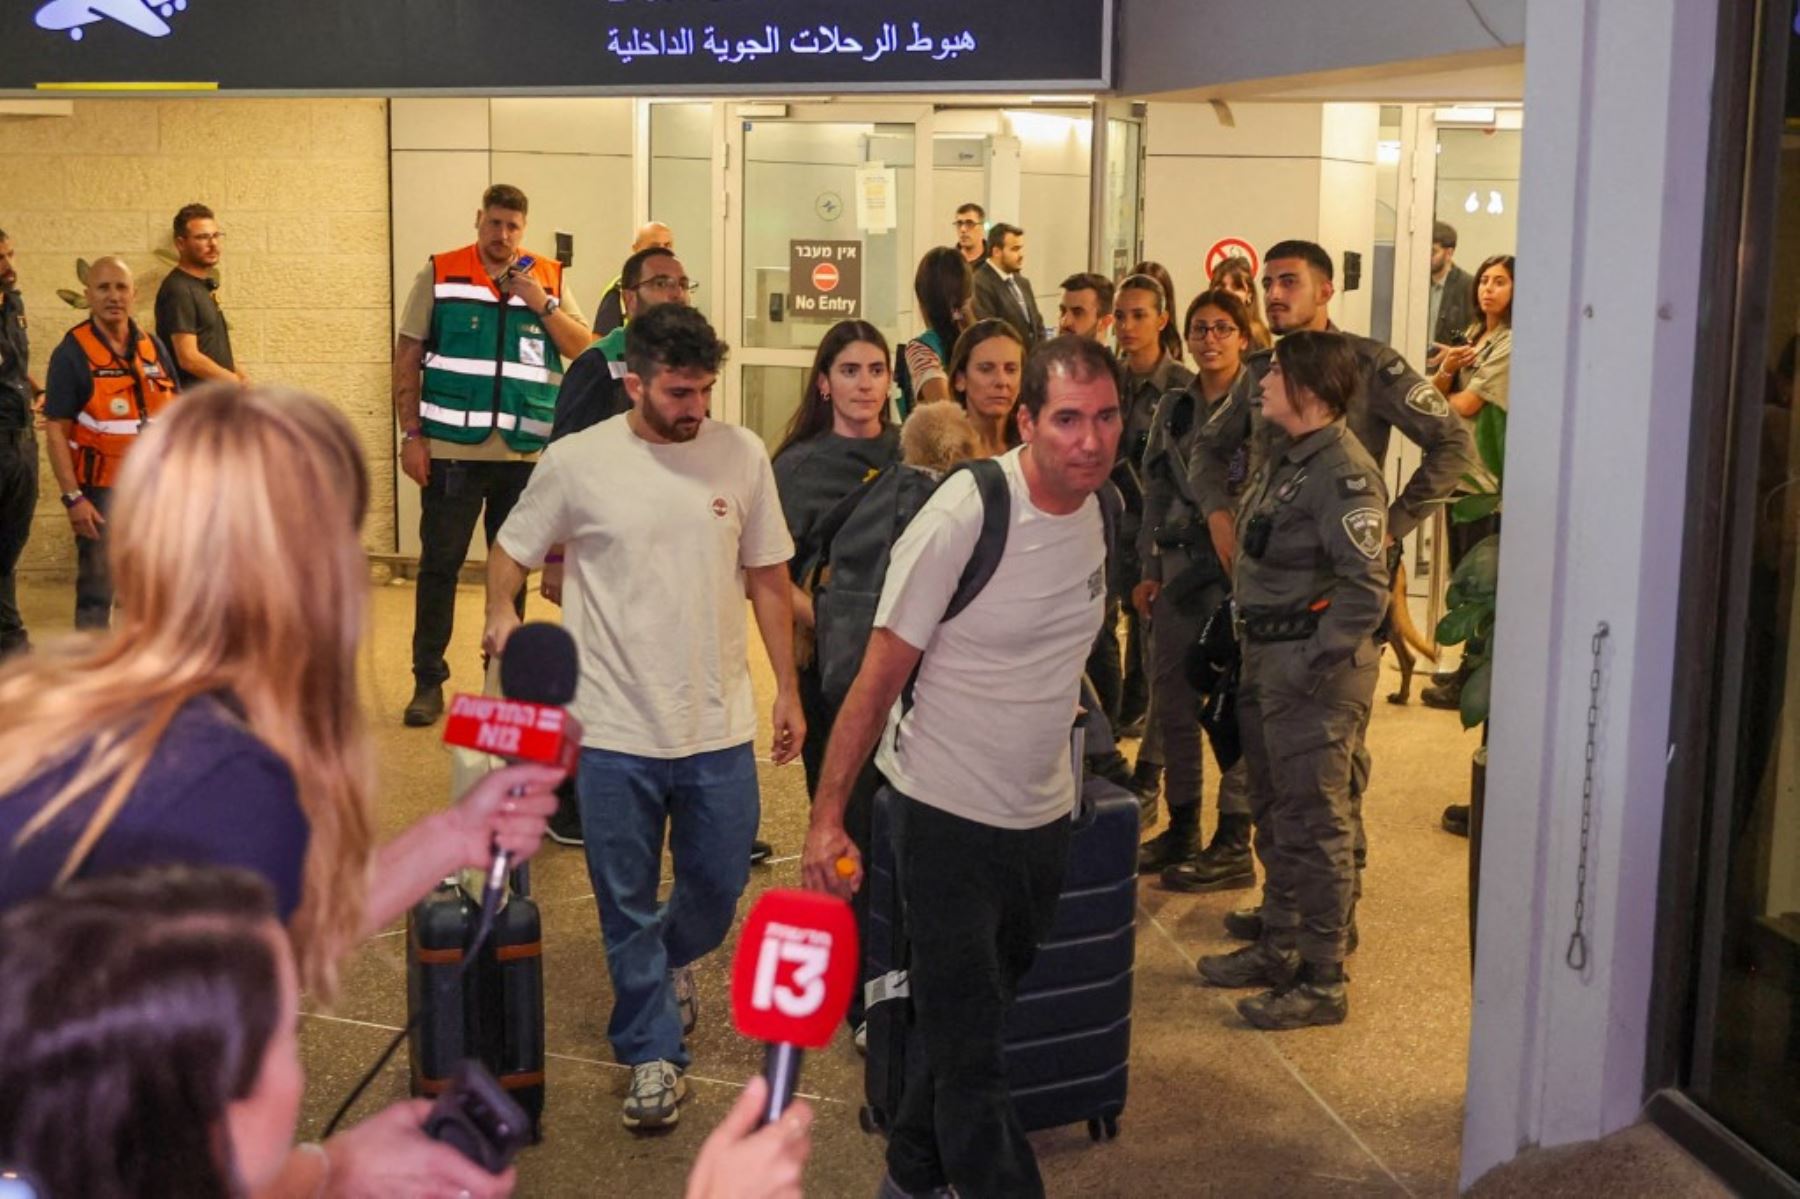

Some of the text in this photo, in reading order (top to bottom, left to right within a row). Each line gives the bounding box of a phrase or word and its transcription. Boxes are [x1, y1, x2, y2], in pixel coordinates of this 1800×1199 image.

[607, 22, 976, 64] هبوط الرحلات الجوية الداخلية
[795, 245, 857, 261] אין מעבר
[795, 294, 857, 314] No Entry
[752, 937, 830, 1017] 13
